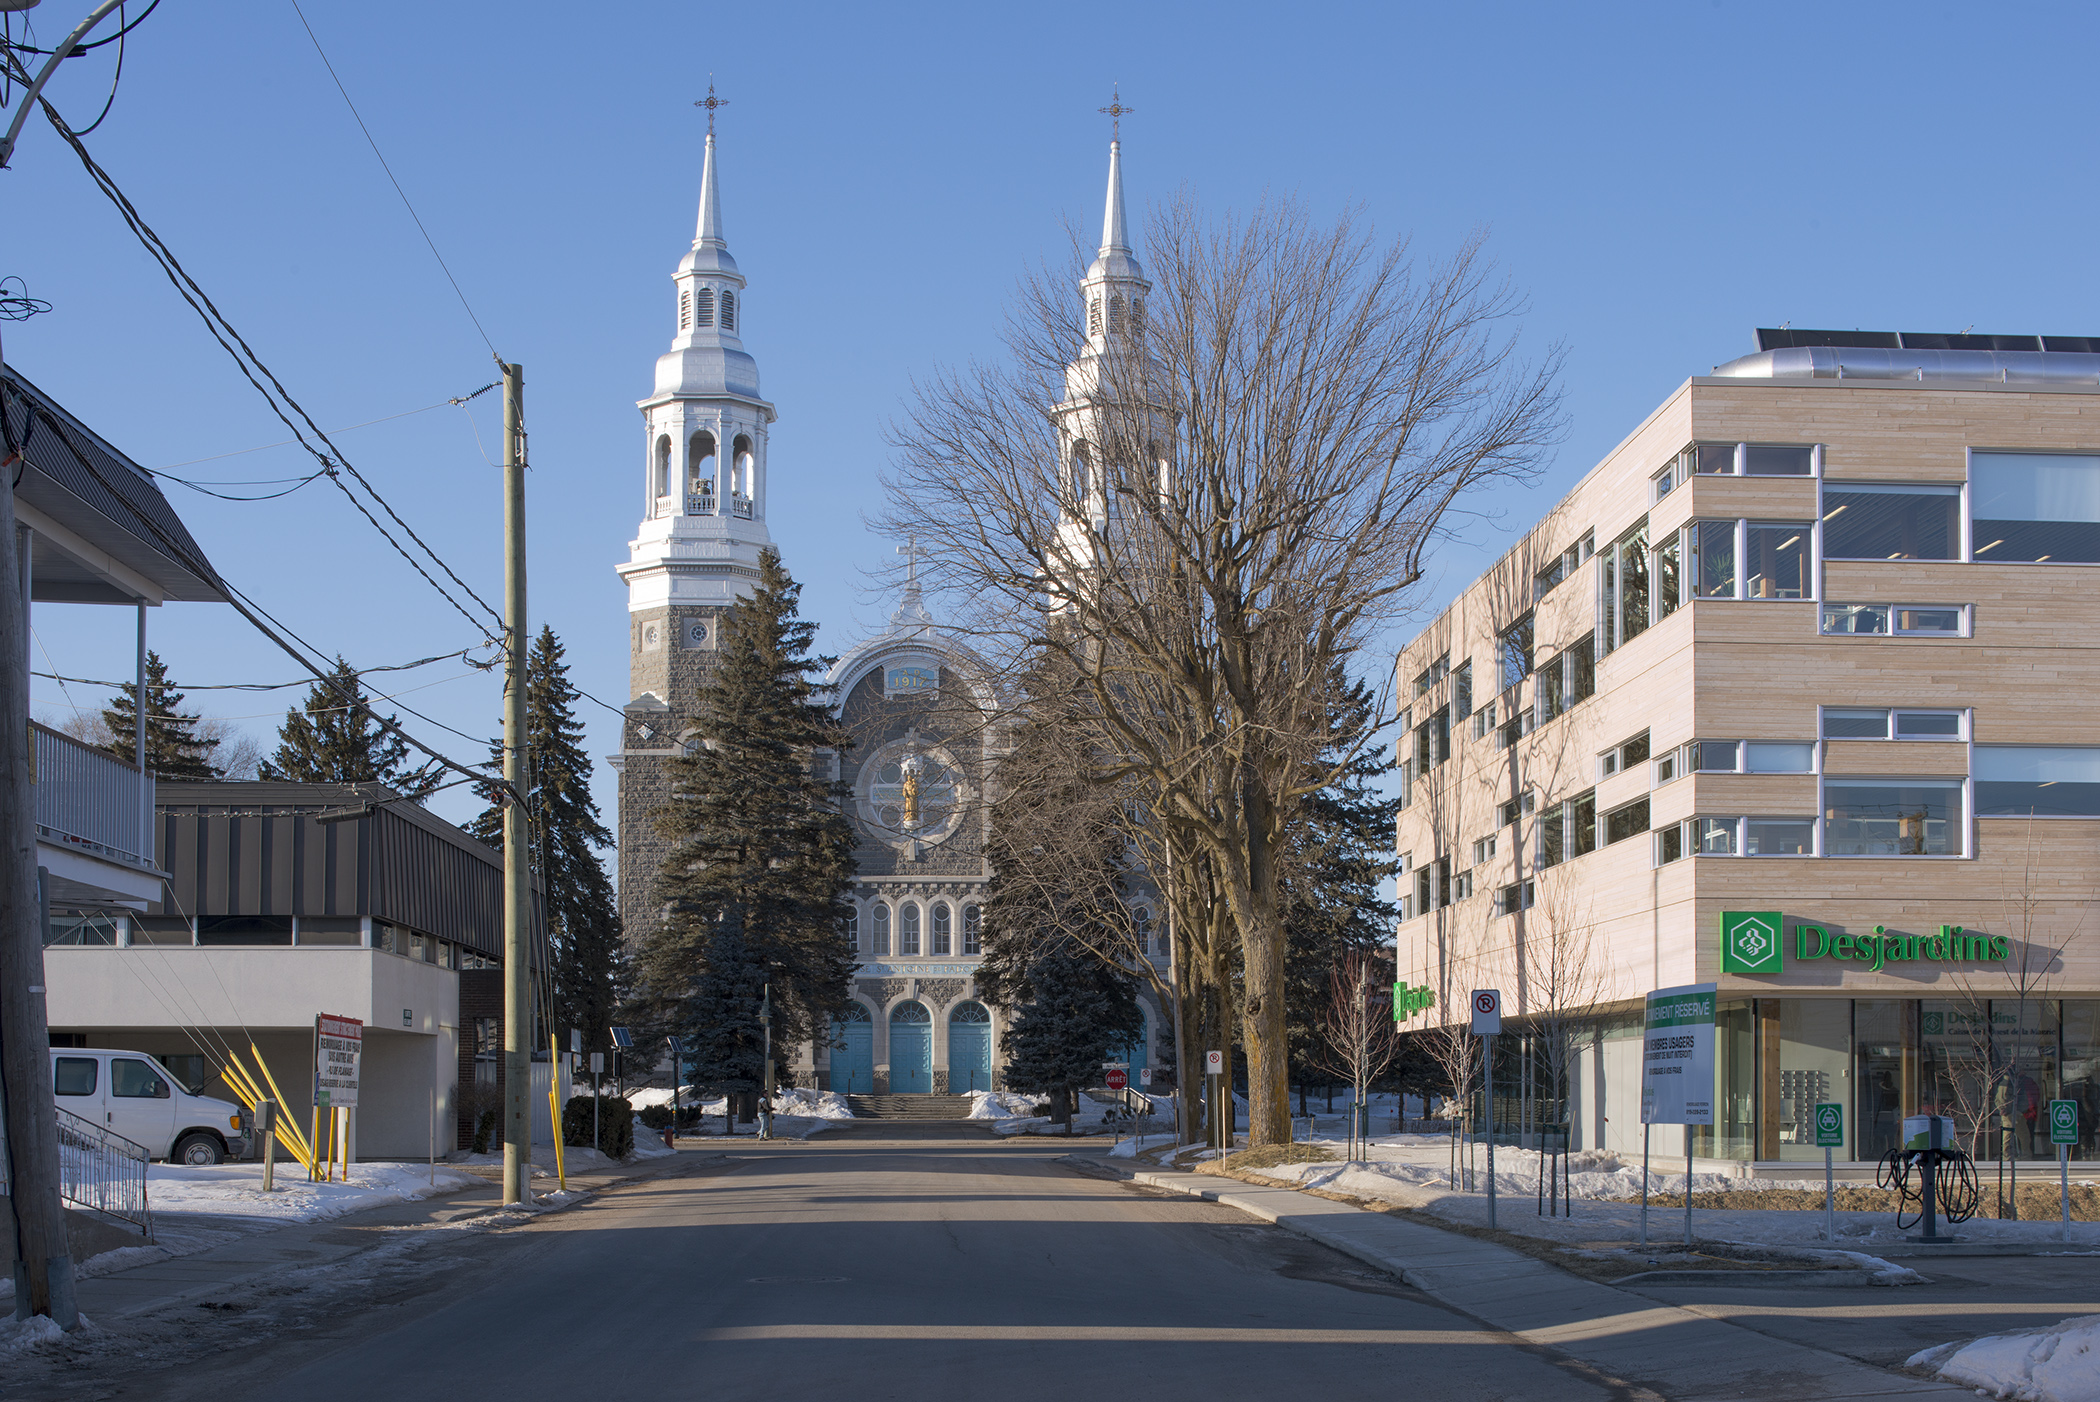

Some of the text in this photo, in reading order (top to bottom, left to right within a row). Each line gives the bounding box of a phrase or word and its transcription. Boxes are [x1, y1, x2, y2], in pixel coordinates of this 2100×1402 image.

[894, 676, 927, 687] 1917
[1796, 924, 2010, 972] Desjardins
[887, 965, 931, 973] ANTOINE
[944, 965, 983, 973] PADOU
[1674, 998, 1710, 1018] RÉSERVÉ
[1947, 1011, 2017, 1027] Desjadins
[1668, 1035, 1695, 1049] USAGERS
[1107, 1074, 1126, 1083] ARRÊT
